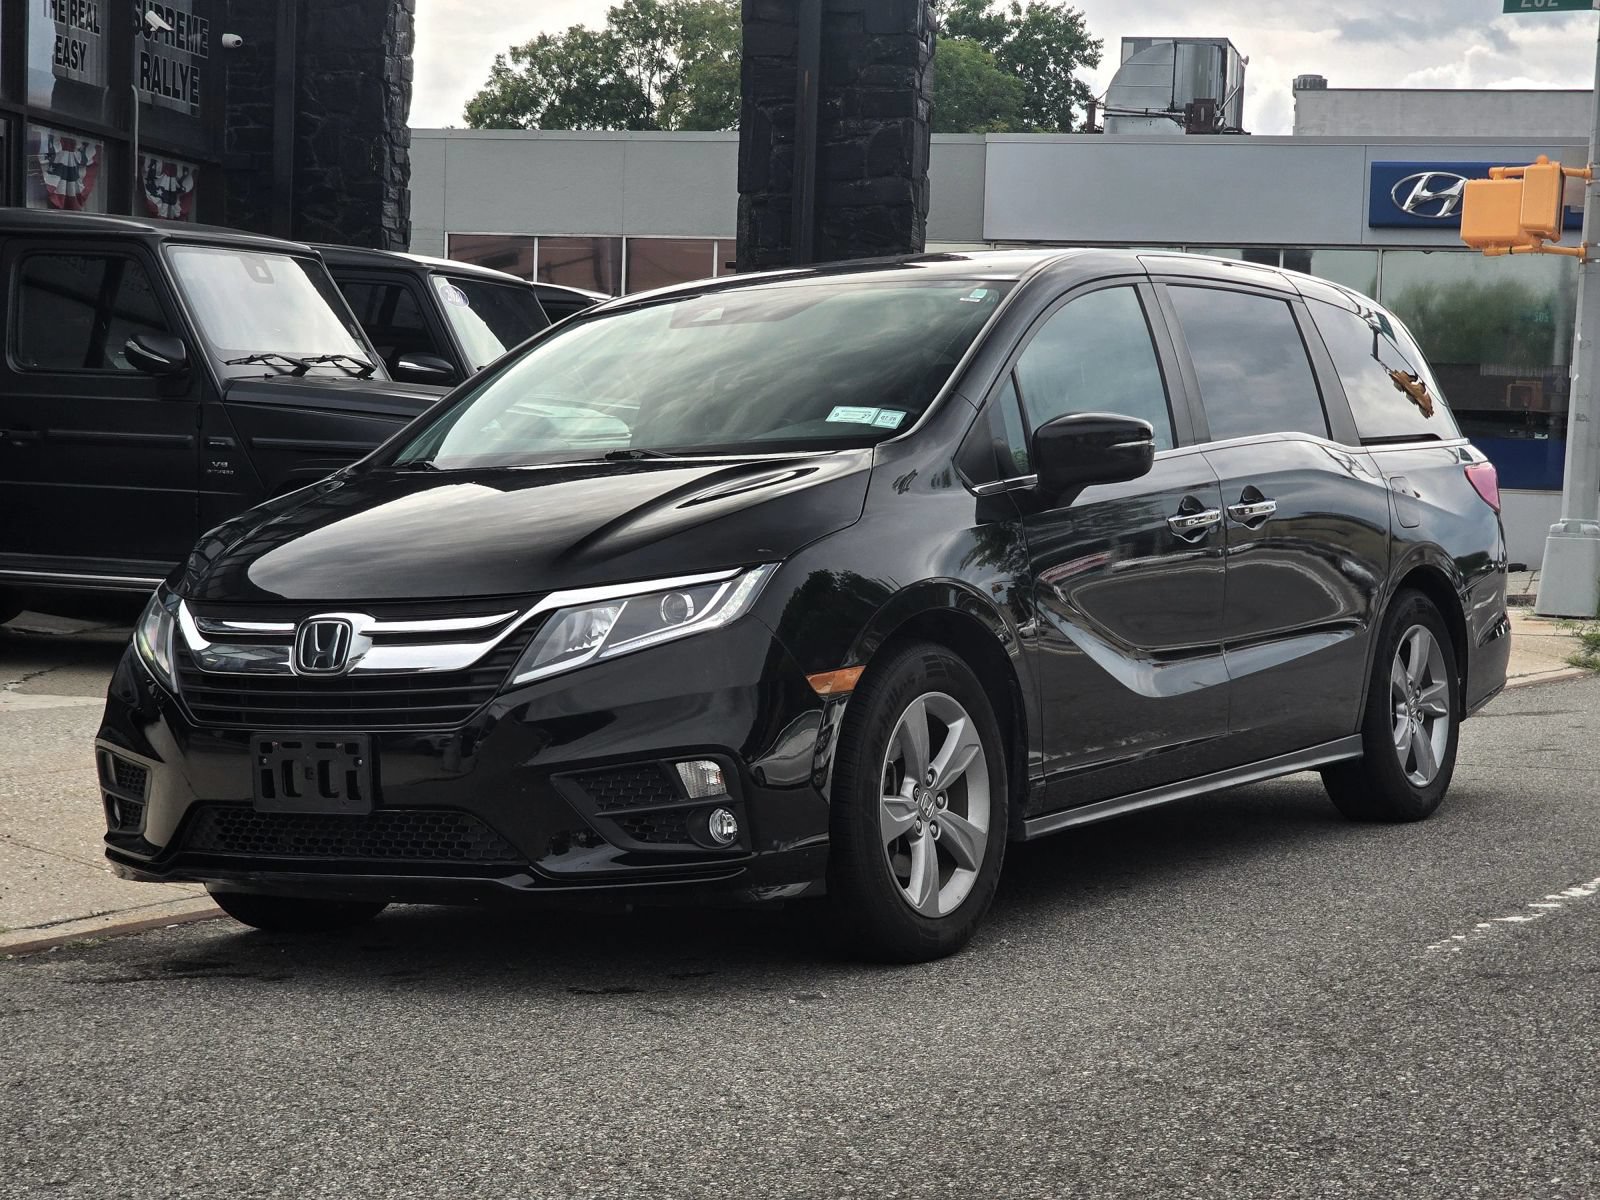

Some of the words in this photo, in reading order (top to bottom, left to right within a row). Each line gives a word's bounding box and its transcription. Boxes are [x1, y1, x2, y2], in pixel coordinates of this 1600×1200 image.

[69, 0, 101, 36] REAL
[134, 0, 209, 58] SUPREME
[54, 34, 88, 72] EASY
[139, 51, 200, 107] RALLYE
